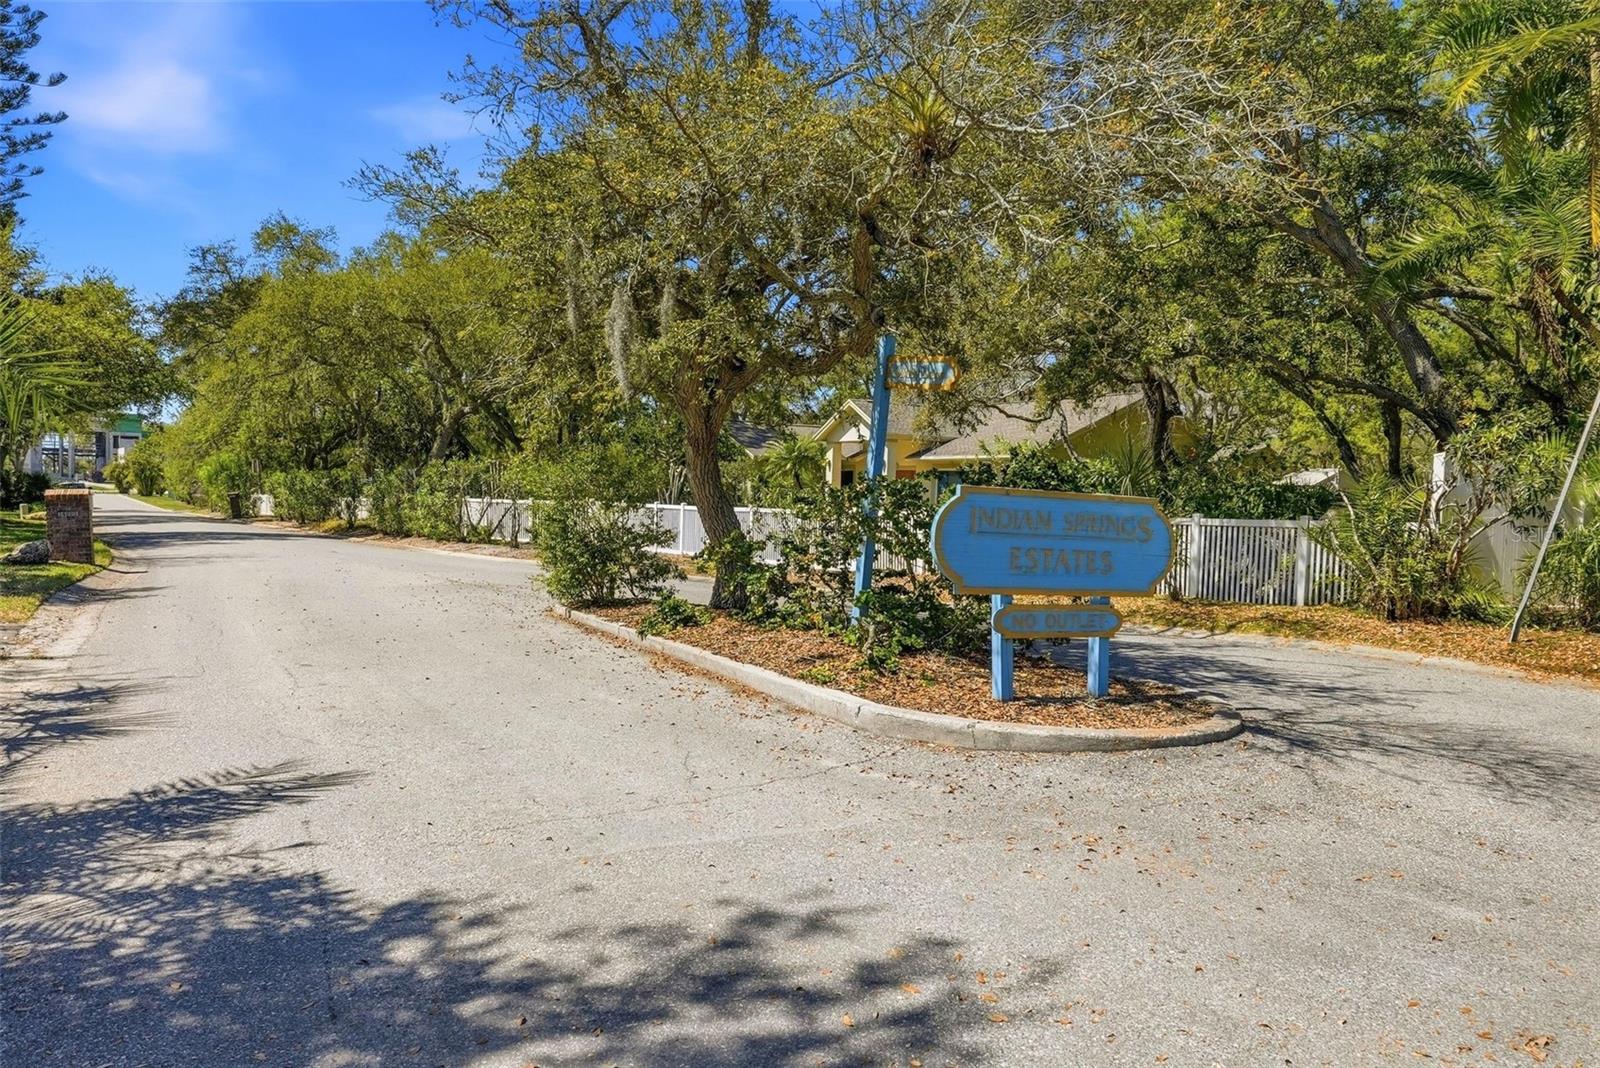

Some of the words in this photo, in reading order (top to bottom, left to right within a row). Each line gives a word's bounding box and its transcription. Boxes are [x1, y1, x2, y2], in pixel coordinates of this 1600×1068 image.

[969, 506, 1052, 534] INDIAN
[1064, 511, 1153, 543] SPRINGS
[1010, 547, 1115, 576] ESTATES
[1012, 613, 1036, 629] NO
[1045, 612, 1108, 629] OUTLET
